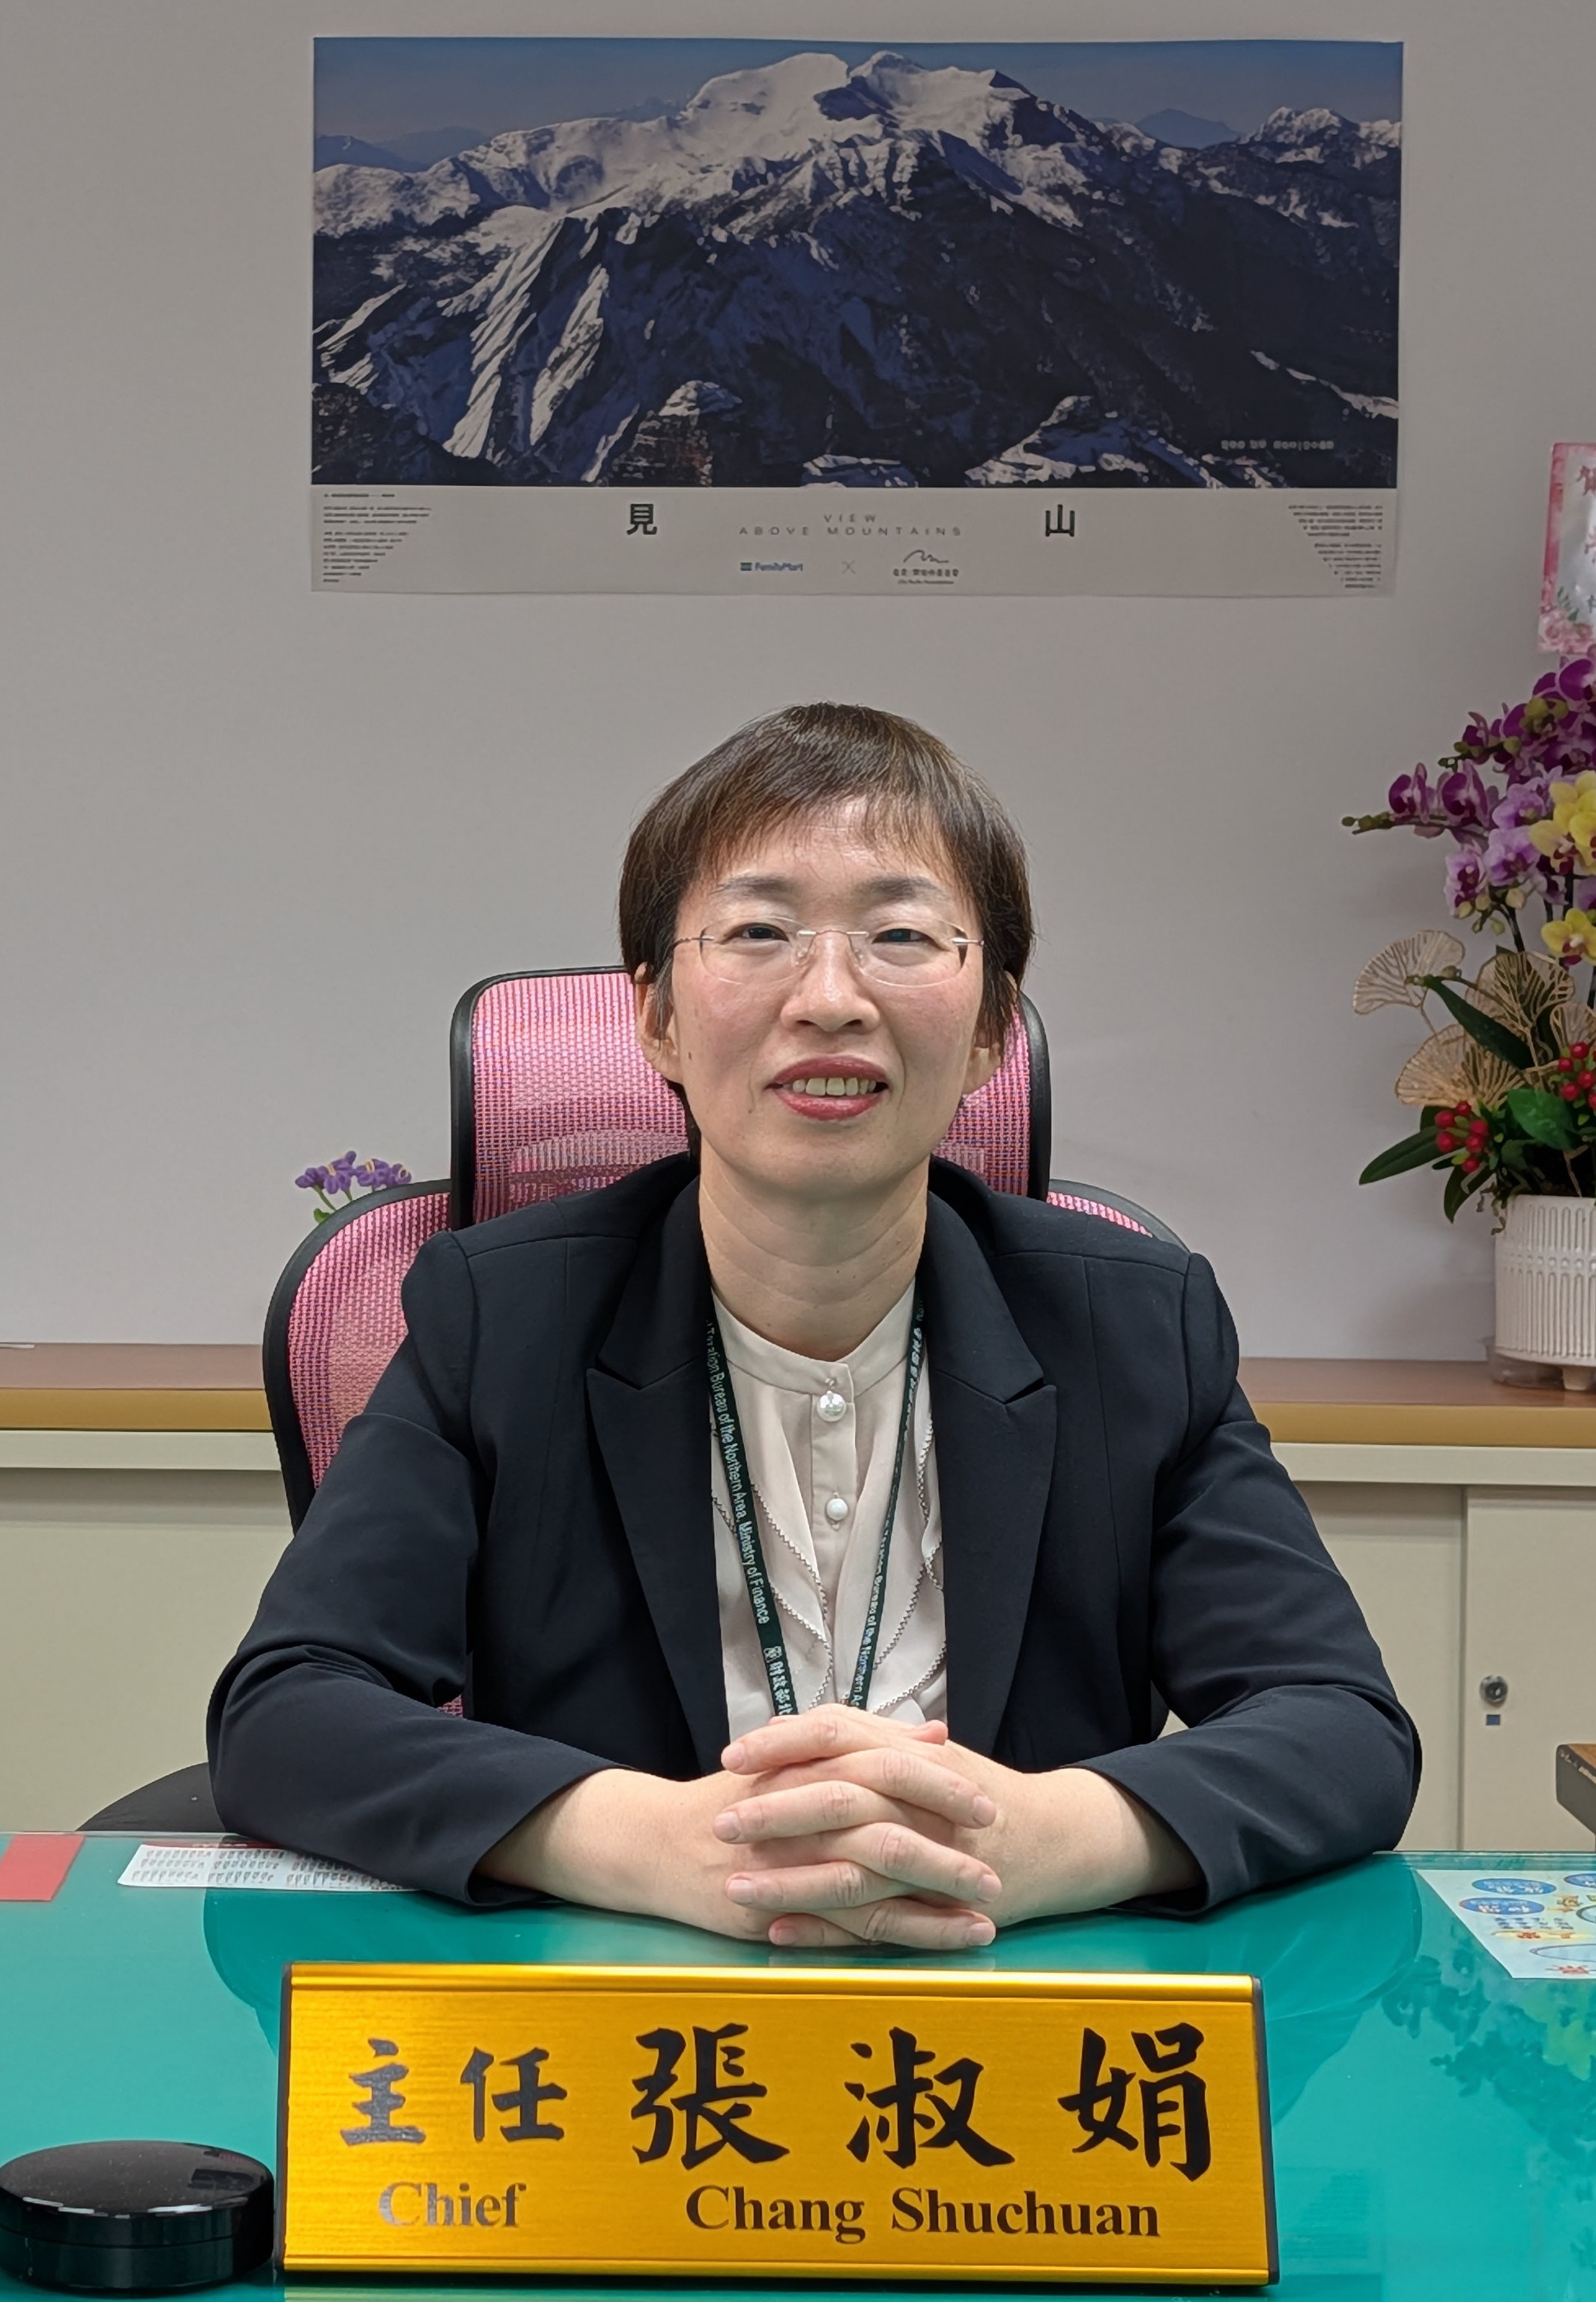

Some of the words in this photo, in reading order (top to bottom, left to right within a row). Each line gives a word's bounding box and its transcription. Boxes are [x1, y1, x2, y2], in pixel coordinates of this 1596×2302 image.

[626, 504, 658, 536] 見
[1045, 504, 1076, 537] 山
[739, 527, 809, 536] ABOVE
[827, 527, 962, 537] MOUNTAINS
[824, 514, 877, 523] VIEW
[710, 1371, 728, 1413] Bureau
[719, 1413, 734, 1425] of
[719, 1425, 736, 1443] the
[724, 1443, 743, 1493] Northern
[738, 1520, 756, 1565] Ministry
[746, 1566, 758, 1579] of
[749, 1578, 770, 1625] Finance
[339, 2037, 567, 2145] 主任
[630, 2022, 1212, 2182] 張淑娟
[378, 2182, 527, 2229] Chief
[686, 2185, 866, 2244] Chang
[892, 2187, 1160, 2238] Shuchuan
